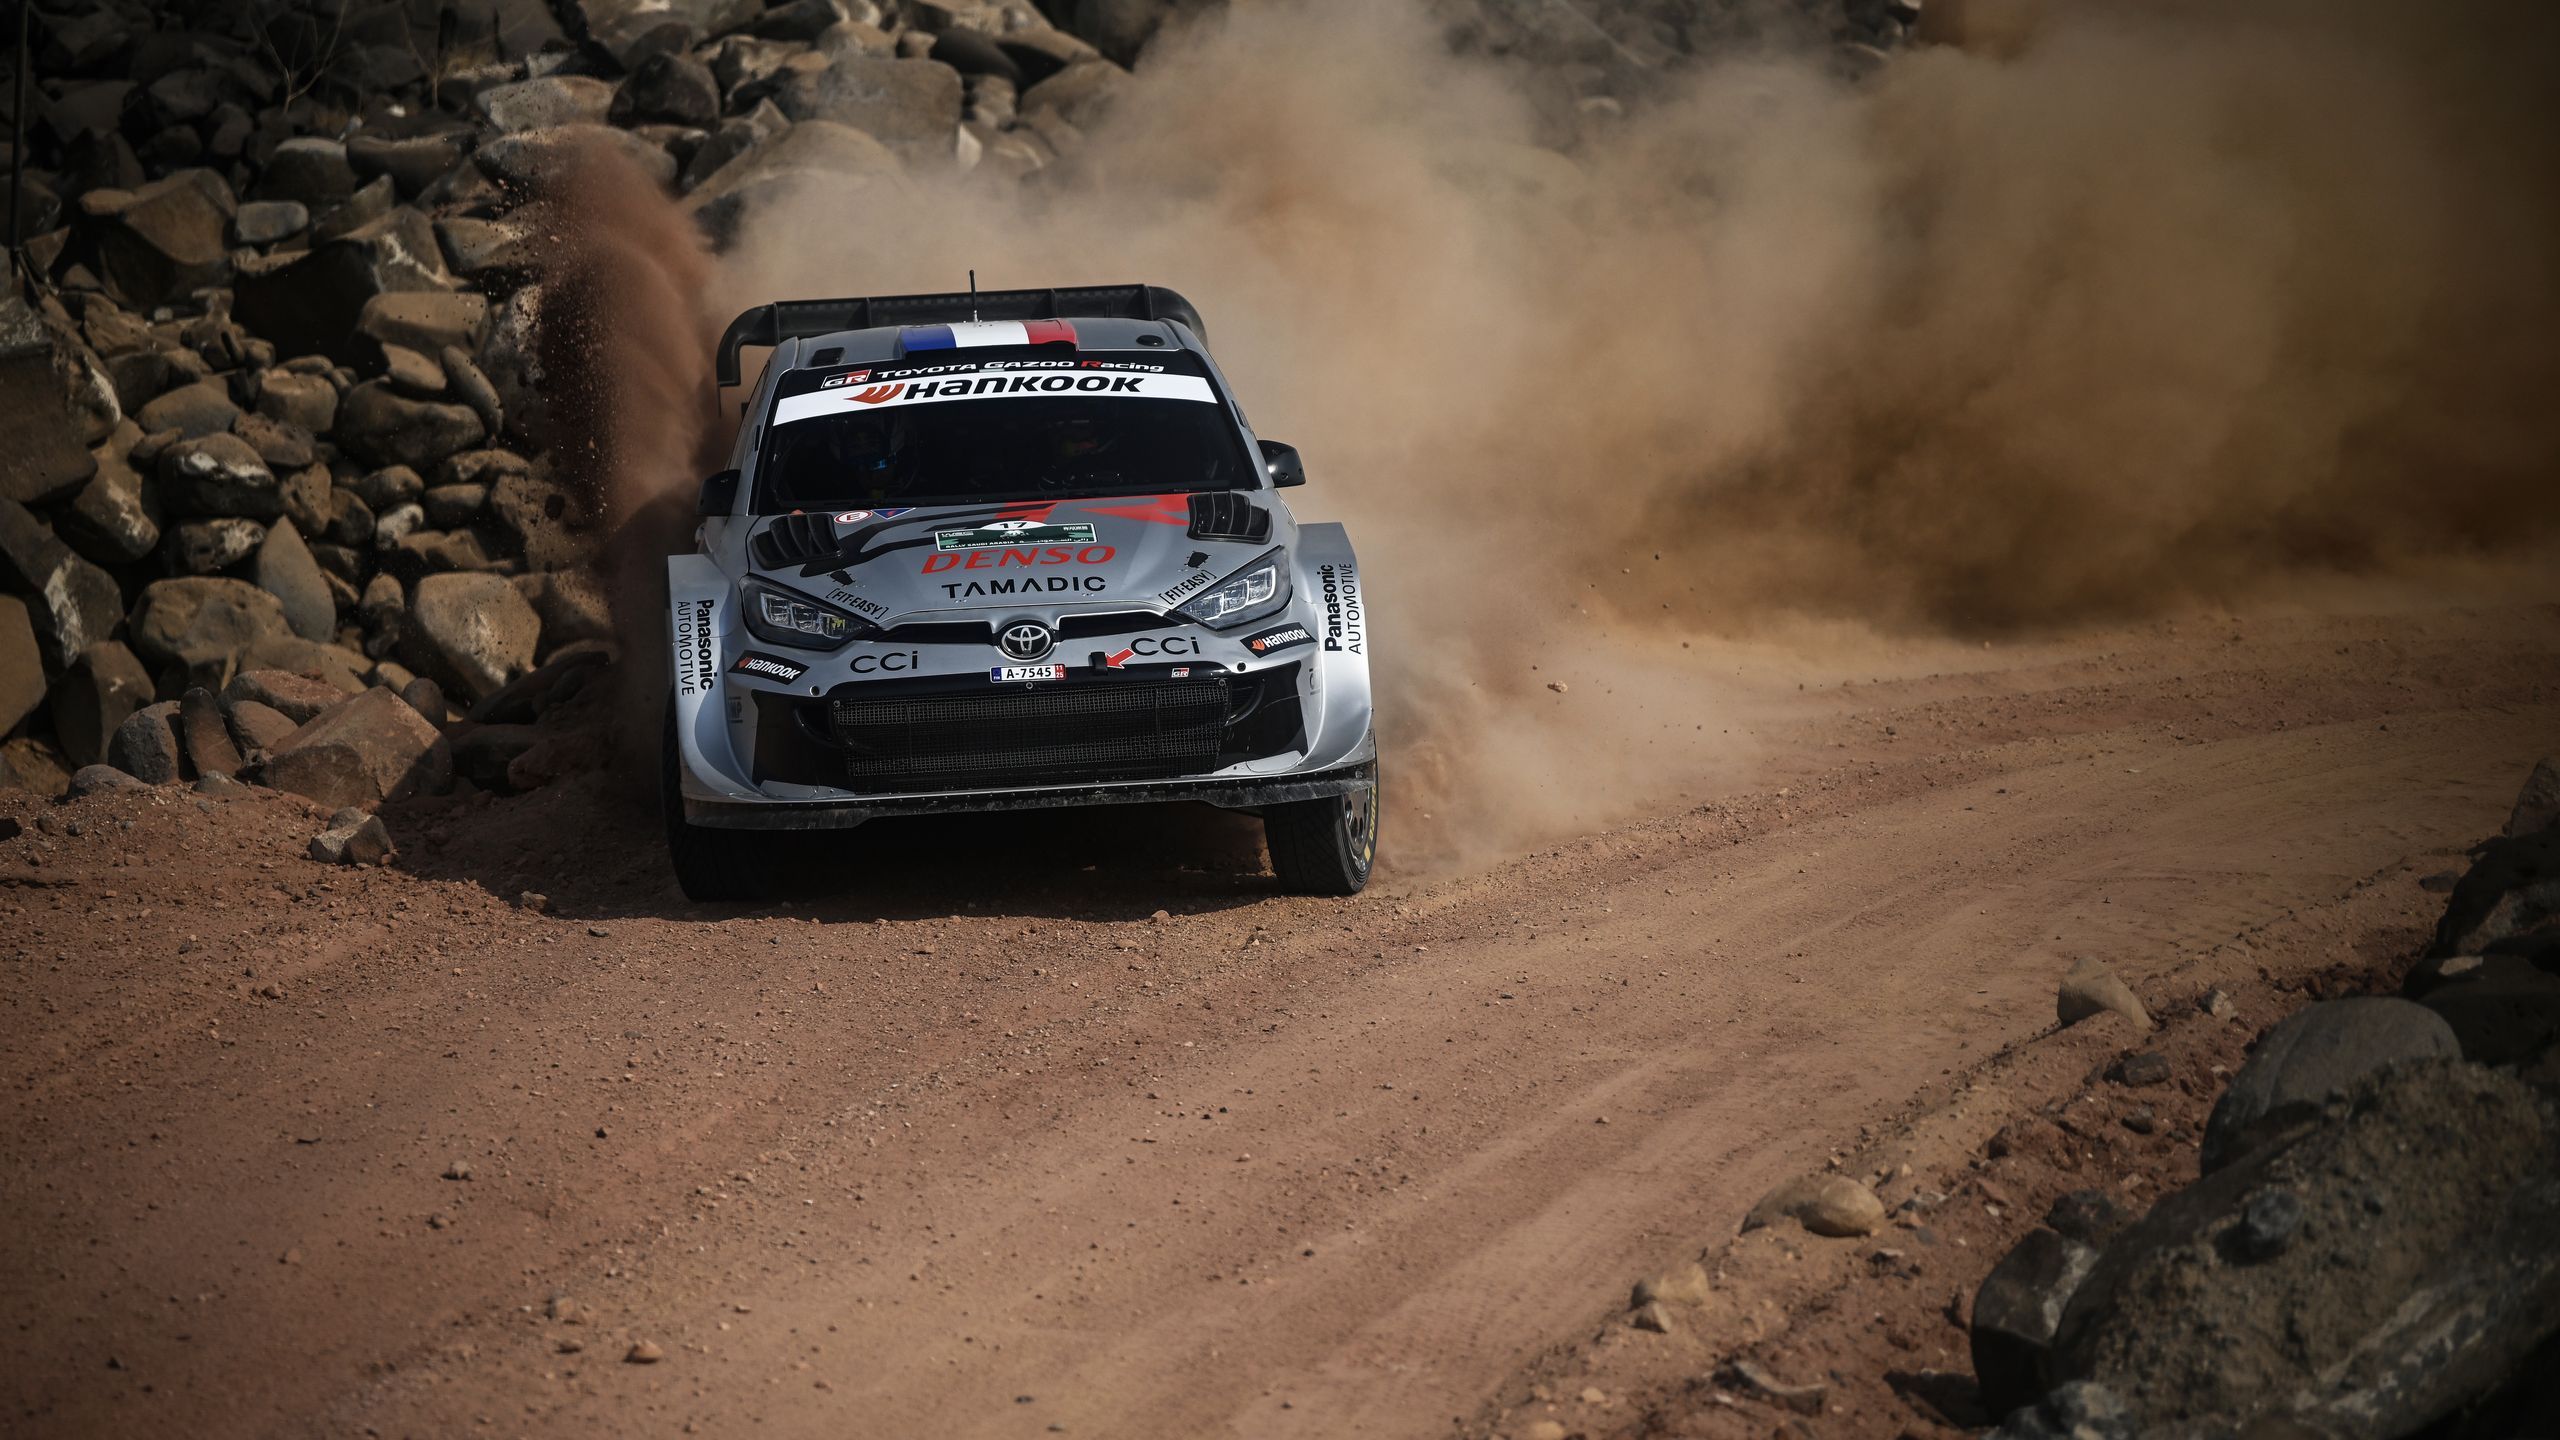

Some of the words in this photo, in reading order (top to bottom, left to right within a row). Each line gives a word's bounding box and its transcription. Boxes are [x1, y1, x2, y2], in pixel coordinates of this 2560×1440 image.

[823, 372, 868, 388] GR
[876, 363, 977, 378] TOYOTA
[984, 361, 1075, 369] GAZOO
[1080, 360, 1165, 372] Racing
[1000, 521, 1028, 529] 17
[921, 546, 1117, 575] DENSO
[941, 576, 1106, 598] TAMADIC
[1317, 564, 1343, 652] Panasonic
[1339, 563, 1362, 655] AUTOMOTIVE
[677, 601, 695, 696] AUTOMOTIVE
[696, 599, 718, 690] Panasonic
[1006, 667, 1051, 679] A-7545
[1055, 671, 1064, 679] 25
